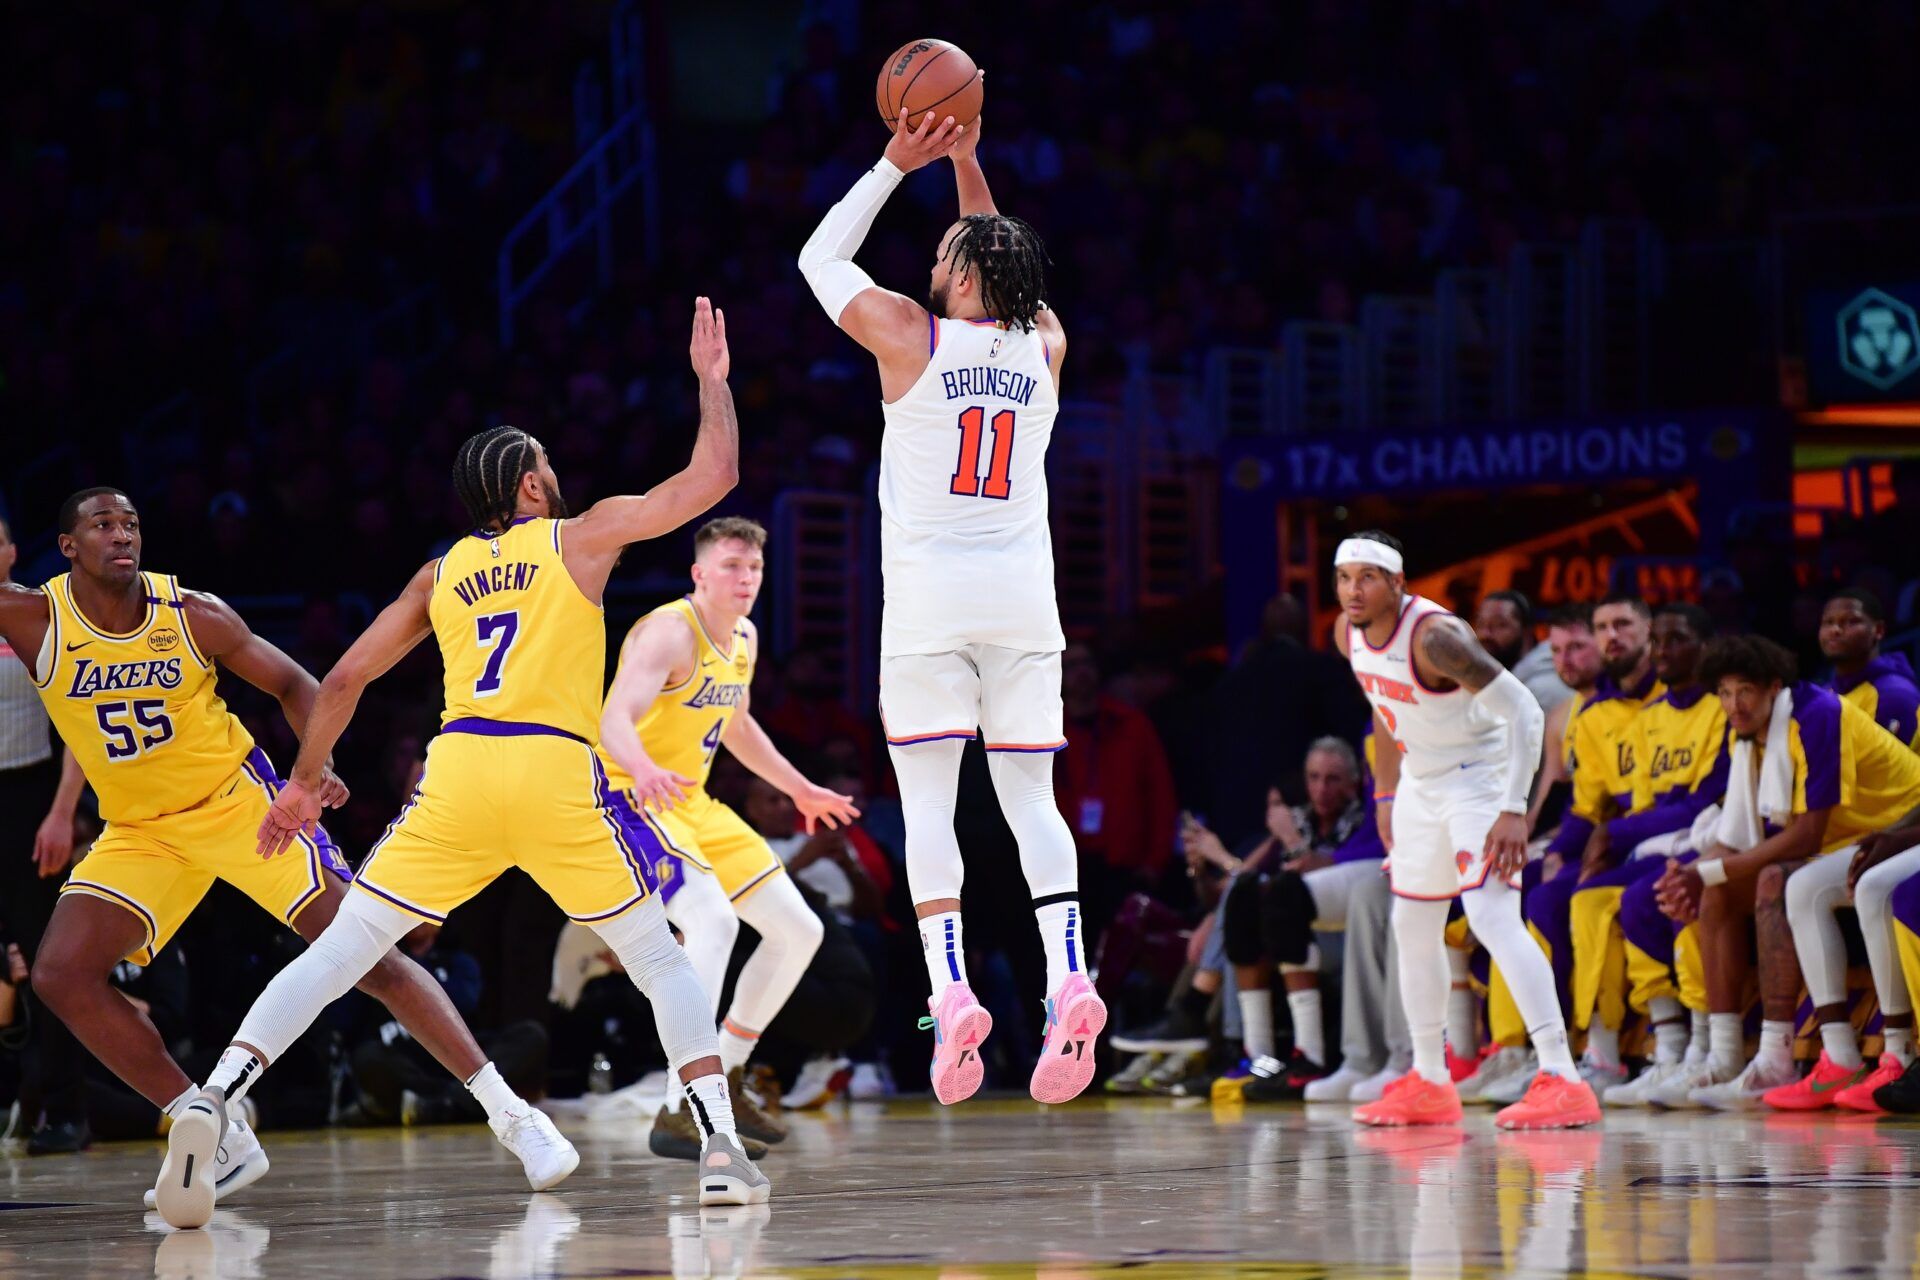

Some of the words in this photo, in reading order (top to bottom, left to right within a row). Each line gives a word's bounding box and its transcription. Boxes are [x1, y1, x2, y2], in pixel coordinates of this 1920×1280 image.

[941, 366, 1037, 407] BRUNSON
[949, 405, 1016, 501] 11
[1284, 443, 1360, 489] 17x
[1371, 421, 1688, 486] CHAMPIONS
[453, 562, 540, 607] VINCENT
[150, 634, 177, 644] bibigo
[474, 610, 520, 699] 7
[65, 657, 183, 698] LAKERS
[682, 676, 746, 709] LAKER
[95, 700, 175, 763] 55
[702, 717, 724, 766] 4
